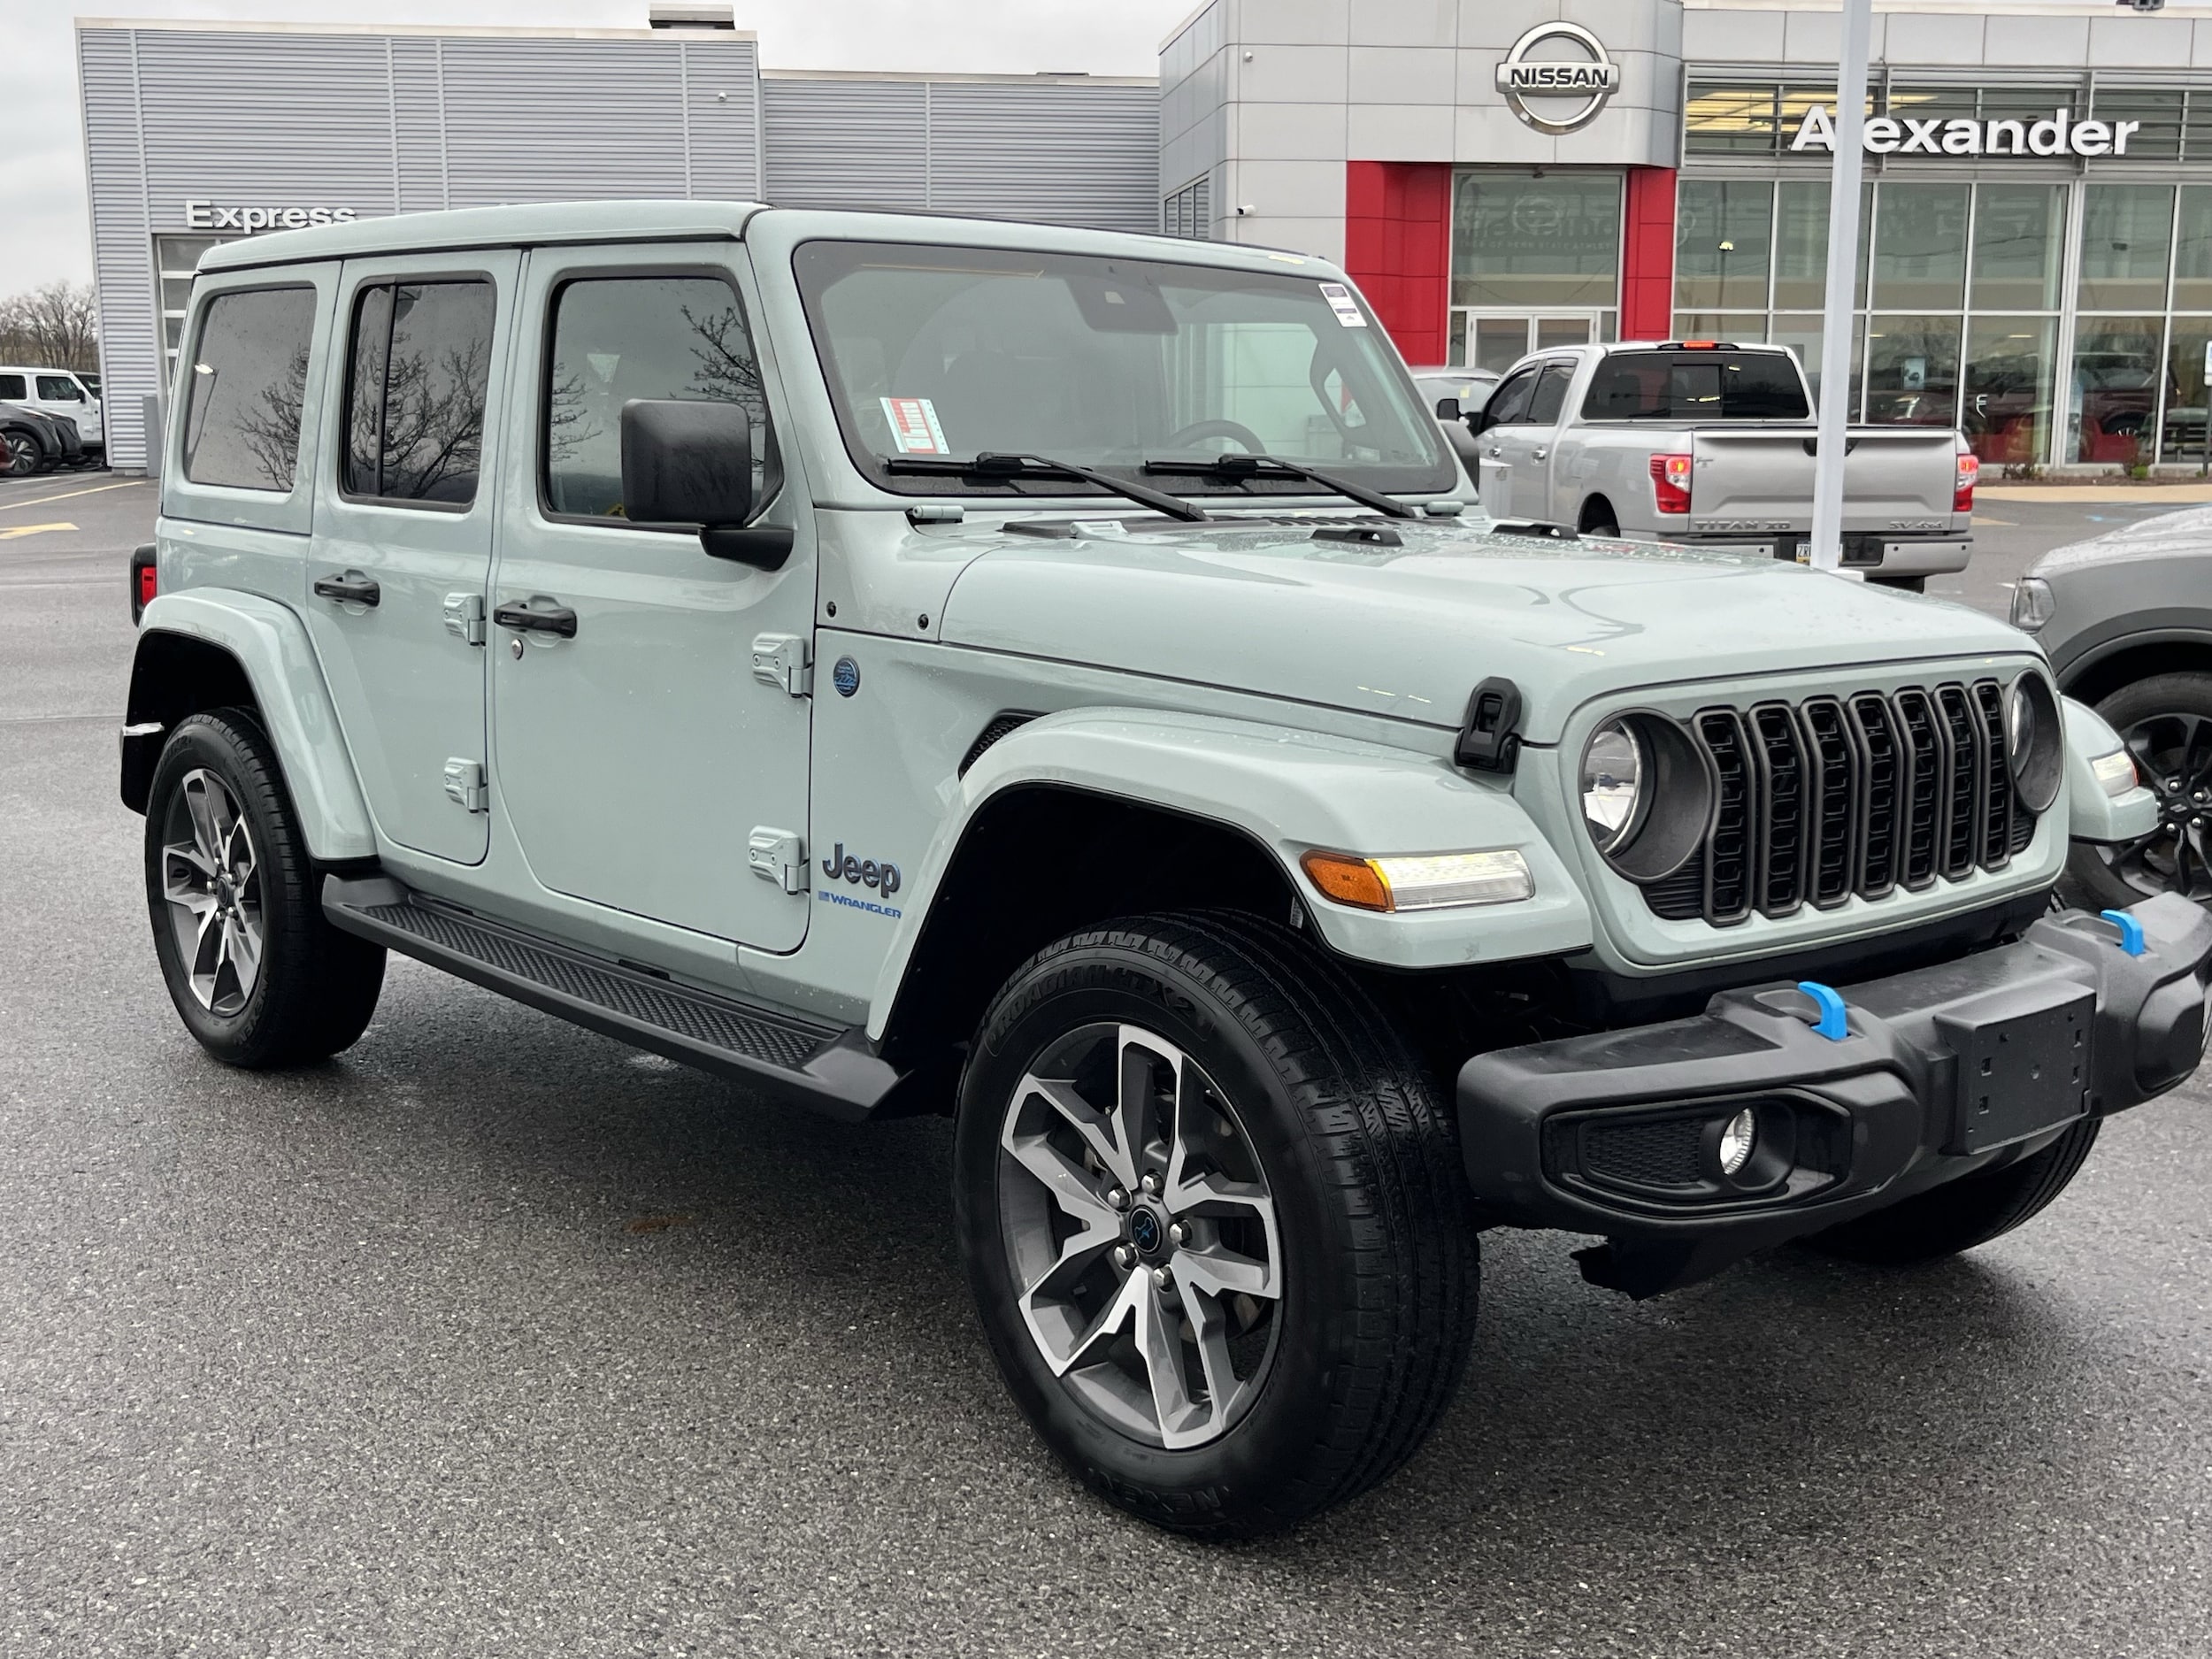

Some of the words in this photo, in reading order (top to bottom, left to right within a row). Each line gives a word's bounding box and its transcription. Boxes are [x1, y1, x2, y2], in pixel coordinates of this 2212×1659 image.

[1510, 68, 1609, 87] NISSAN
[1790, 106, 2139, 155] Aexander
[186, 200, 355, 234] Express
[1694, 520, 1759, 530] TITAN
[1764, 520, 1791, 530] XD
[1889, 520, 1912, 529] SV
[822, 841, 901, 899] Jeep
[830, 893, 902, 919] WRANGLER
